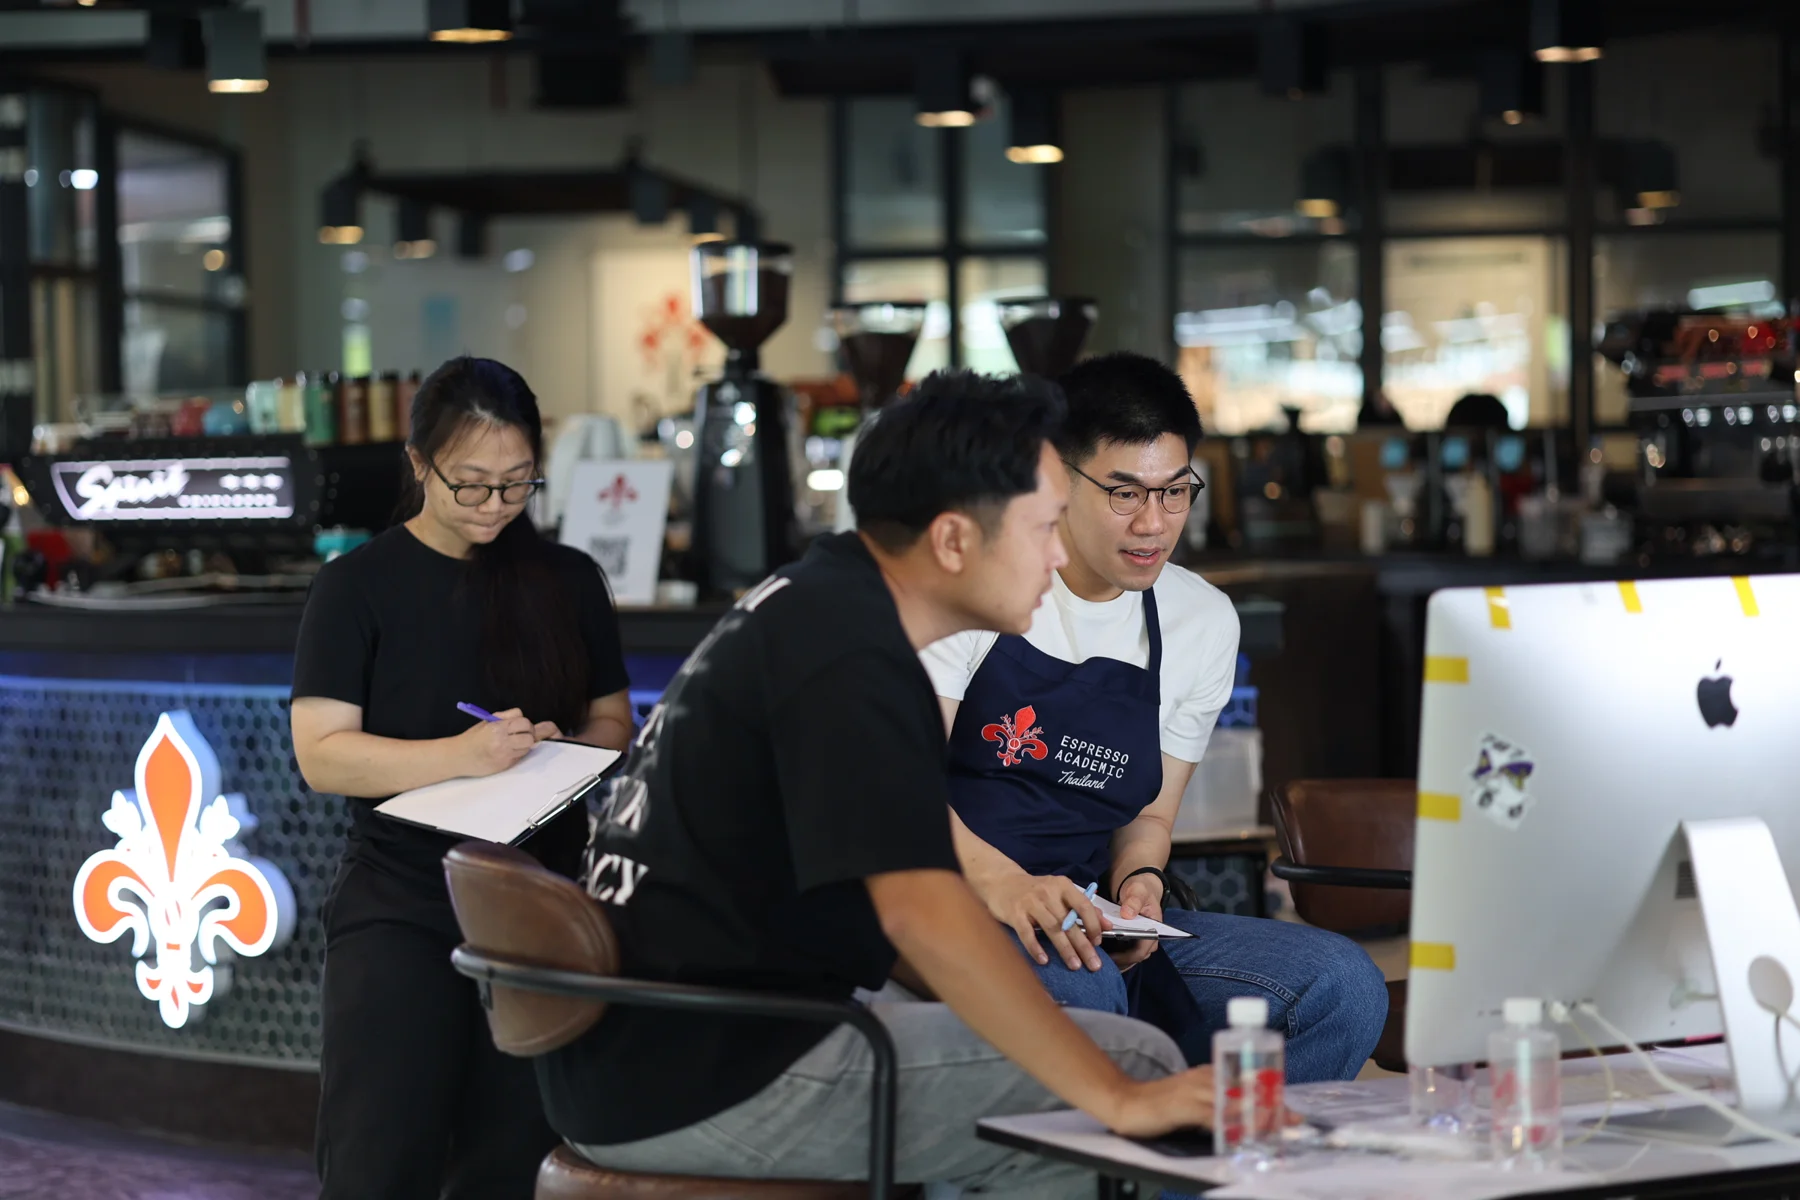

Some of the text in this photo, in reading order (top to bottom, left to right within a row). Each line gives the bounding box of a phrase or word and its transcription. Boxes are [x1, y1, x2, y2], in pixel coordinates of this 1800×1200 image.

[1054, 749, 1124, 779] ACADEMIC
[1060, 735, 1129, 765] ESPRESSO
[1058, 770, 1109, 790] Thailand
